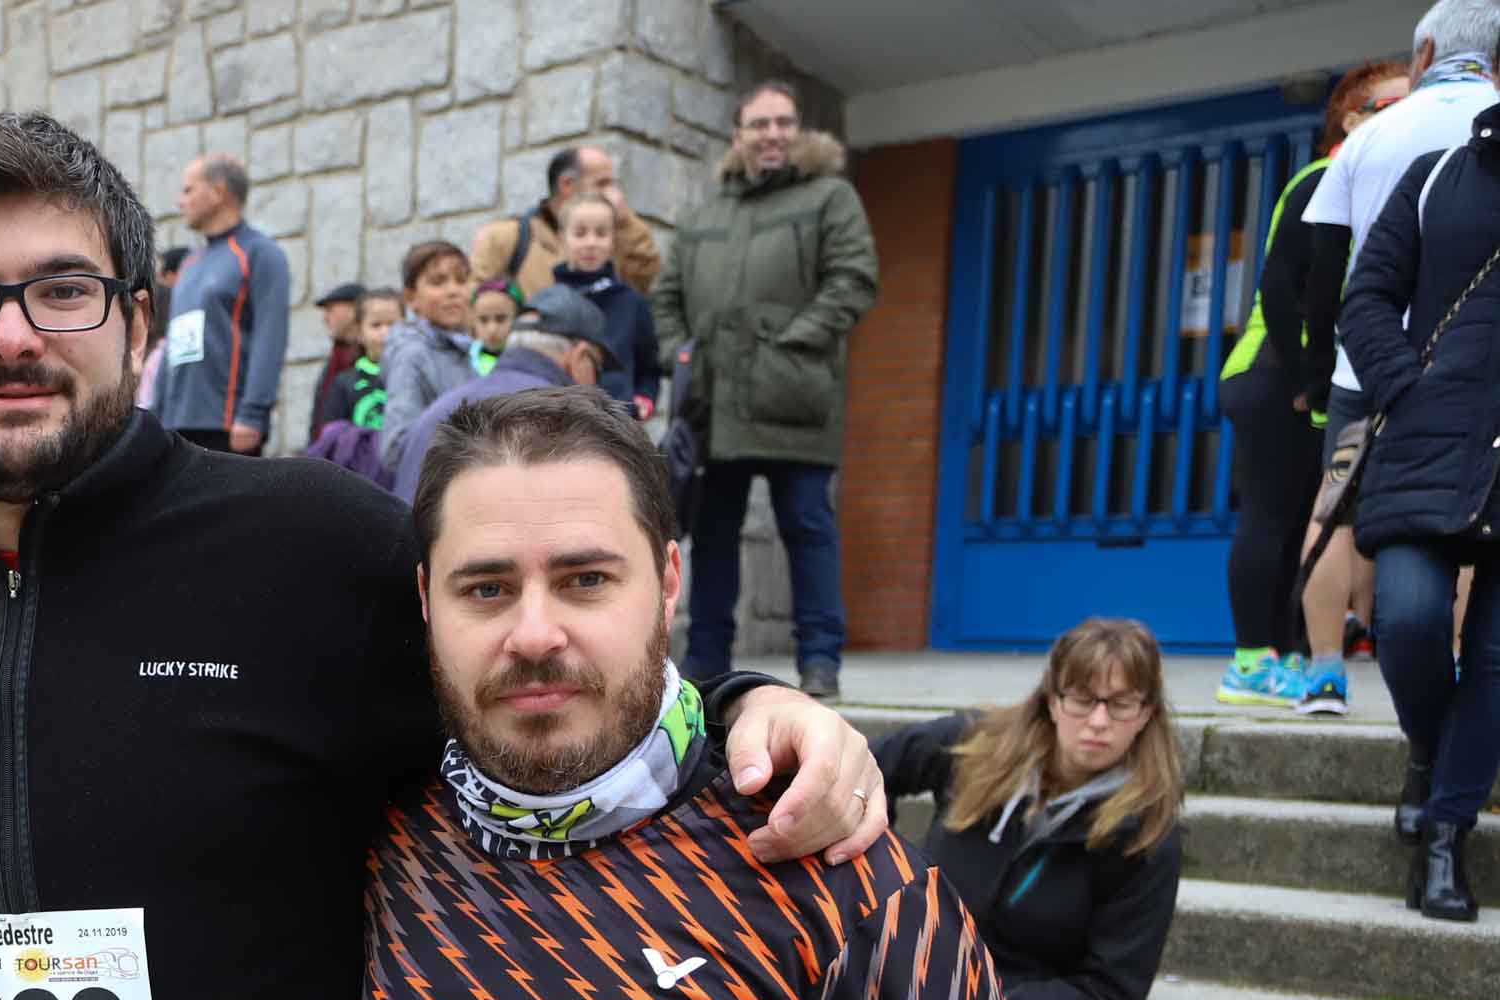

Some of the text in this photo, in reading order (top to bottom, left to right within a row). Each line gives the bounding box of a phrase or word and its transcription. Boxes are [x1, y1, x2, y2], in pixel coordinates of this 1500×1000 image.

[139, 661, 239, 679] LUCKY STRIKE
[77, 927, 128, 938] 24.11.2019
